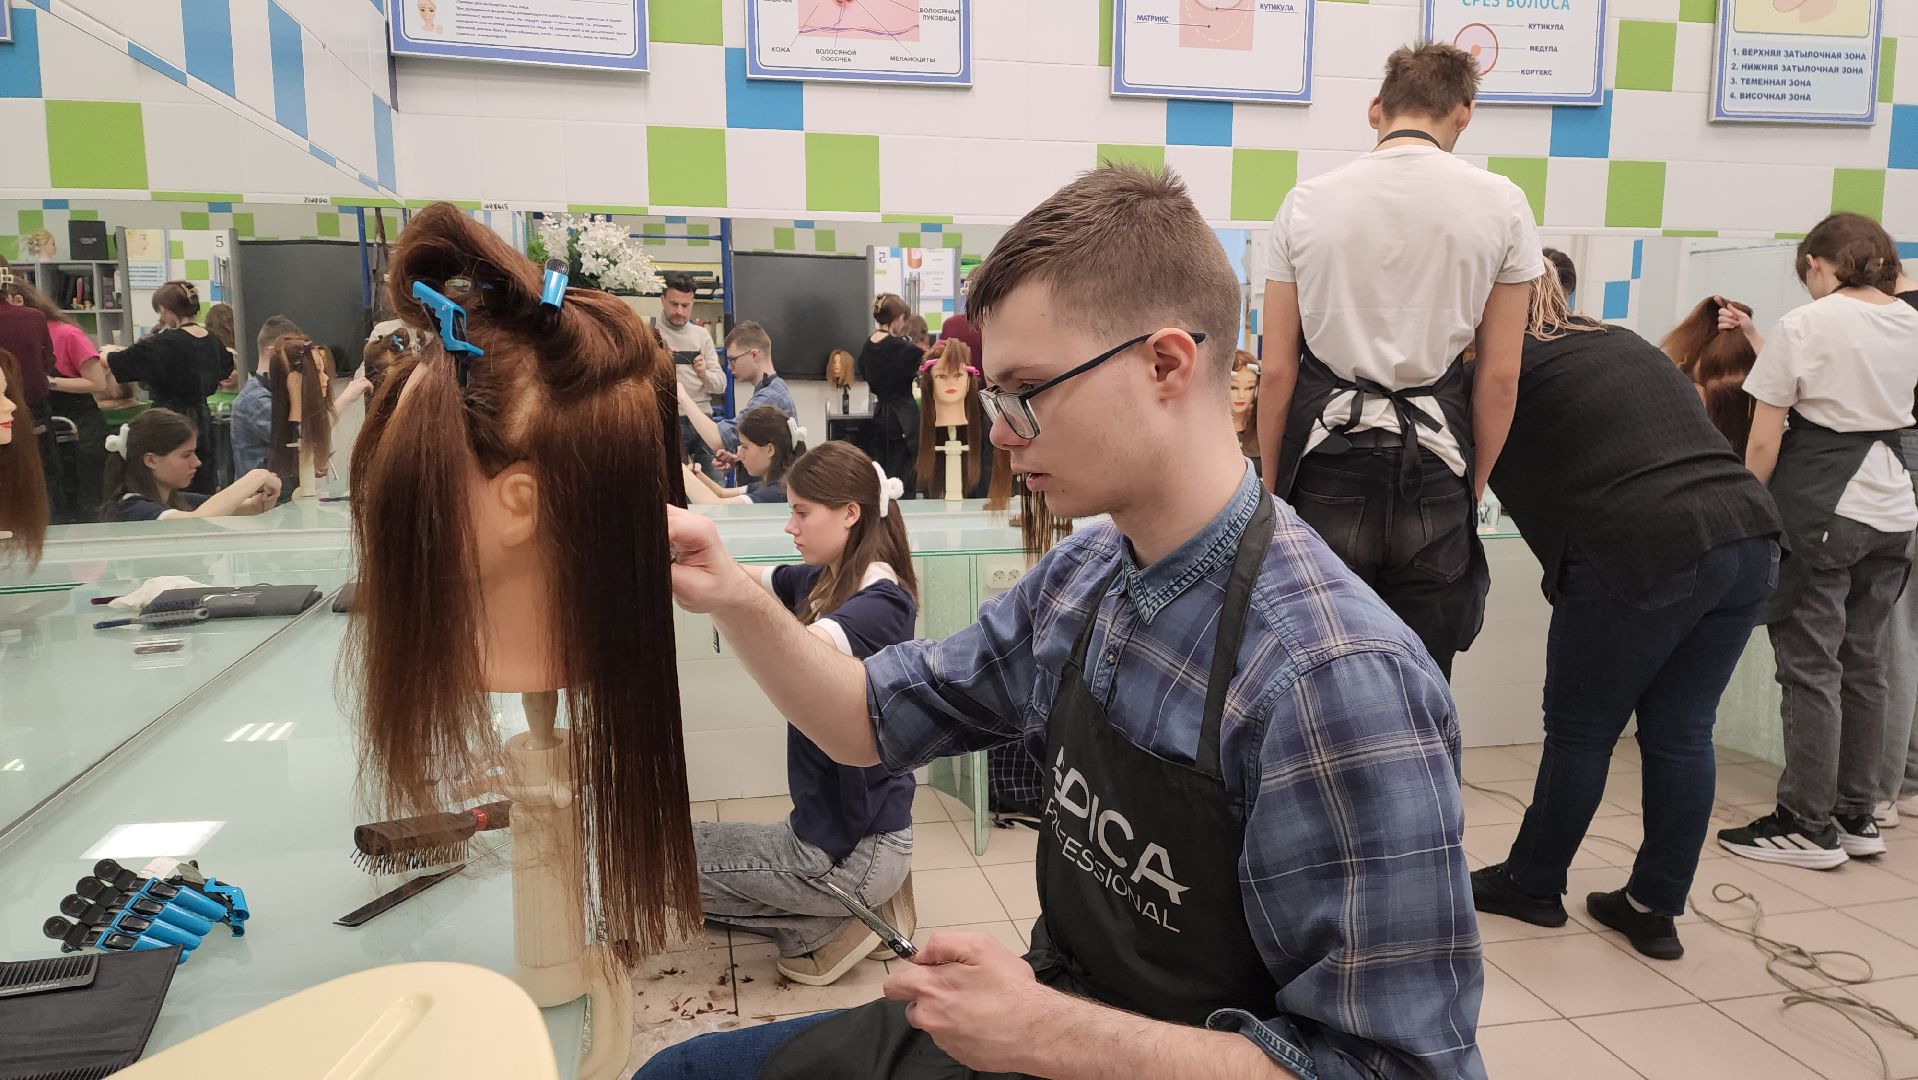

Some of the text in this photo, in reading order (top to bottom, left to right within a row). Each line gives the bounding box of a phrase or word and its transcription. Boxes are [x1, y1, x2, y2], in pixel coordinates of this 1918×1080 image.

[1136, 14, 1169, 23] МАТРИКС
[1528, 22, 1565, 31] КУТИКУЛА
[815, 48, 857, 56] ВОЛОСЯНОЙ
[1529, 45, 1559, 53] МЕДУЛА
[889, 55, 936, 63] МЕЛАНОЦИТЫ
[1732, 48, 1867, 61] 1. ВЕРХНЯЯ ЗАТЫЛОЧНАЯ ЗОНА
[1731, 62, 1864, 75] 2. НИЖНЯЯ ЗАТЫЛОЧНАЯ ЗОНА
[1730, 77, 1812, 88] 3. ТЕМЕННАЯ ЗОНА
[1729, 91, 1812, 102] 4. ВИСОЧНАЯ ЗОНА
[215, 235, 225, 248] 5
